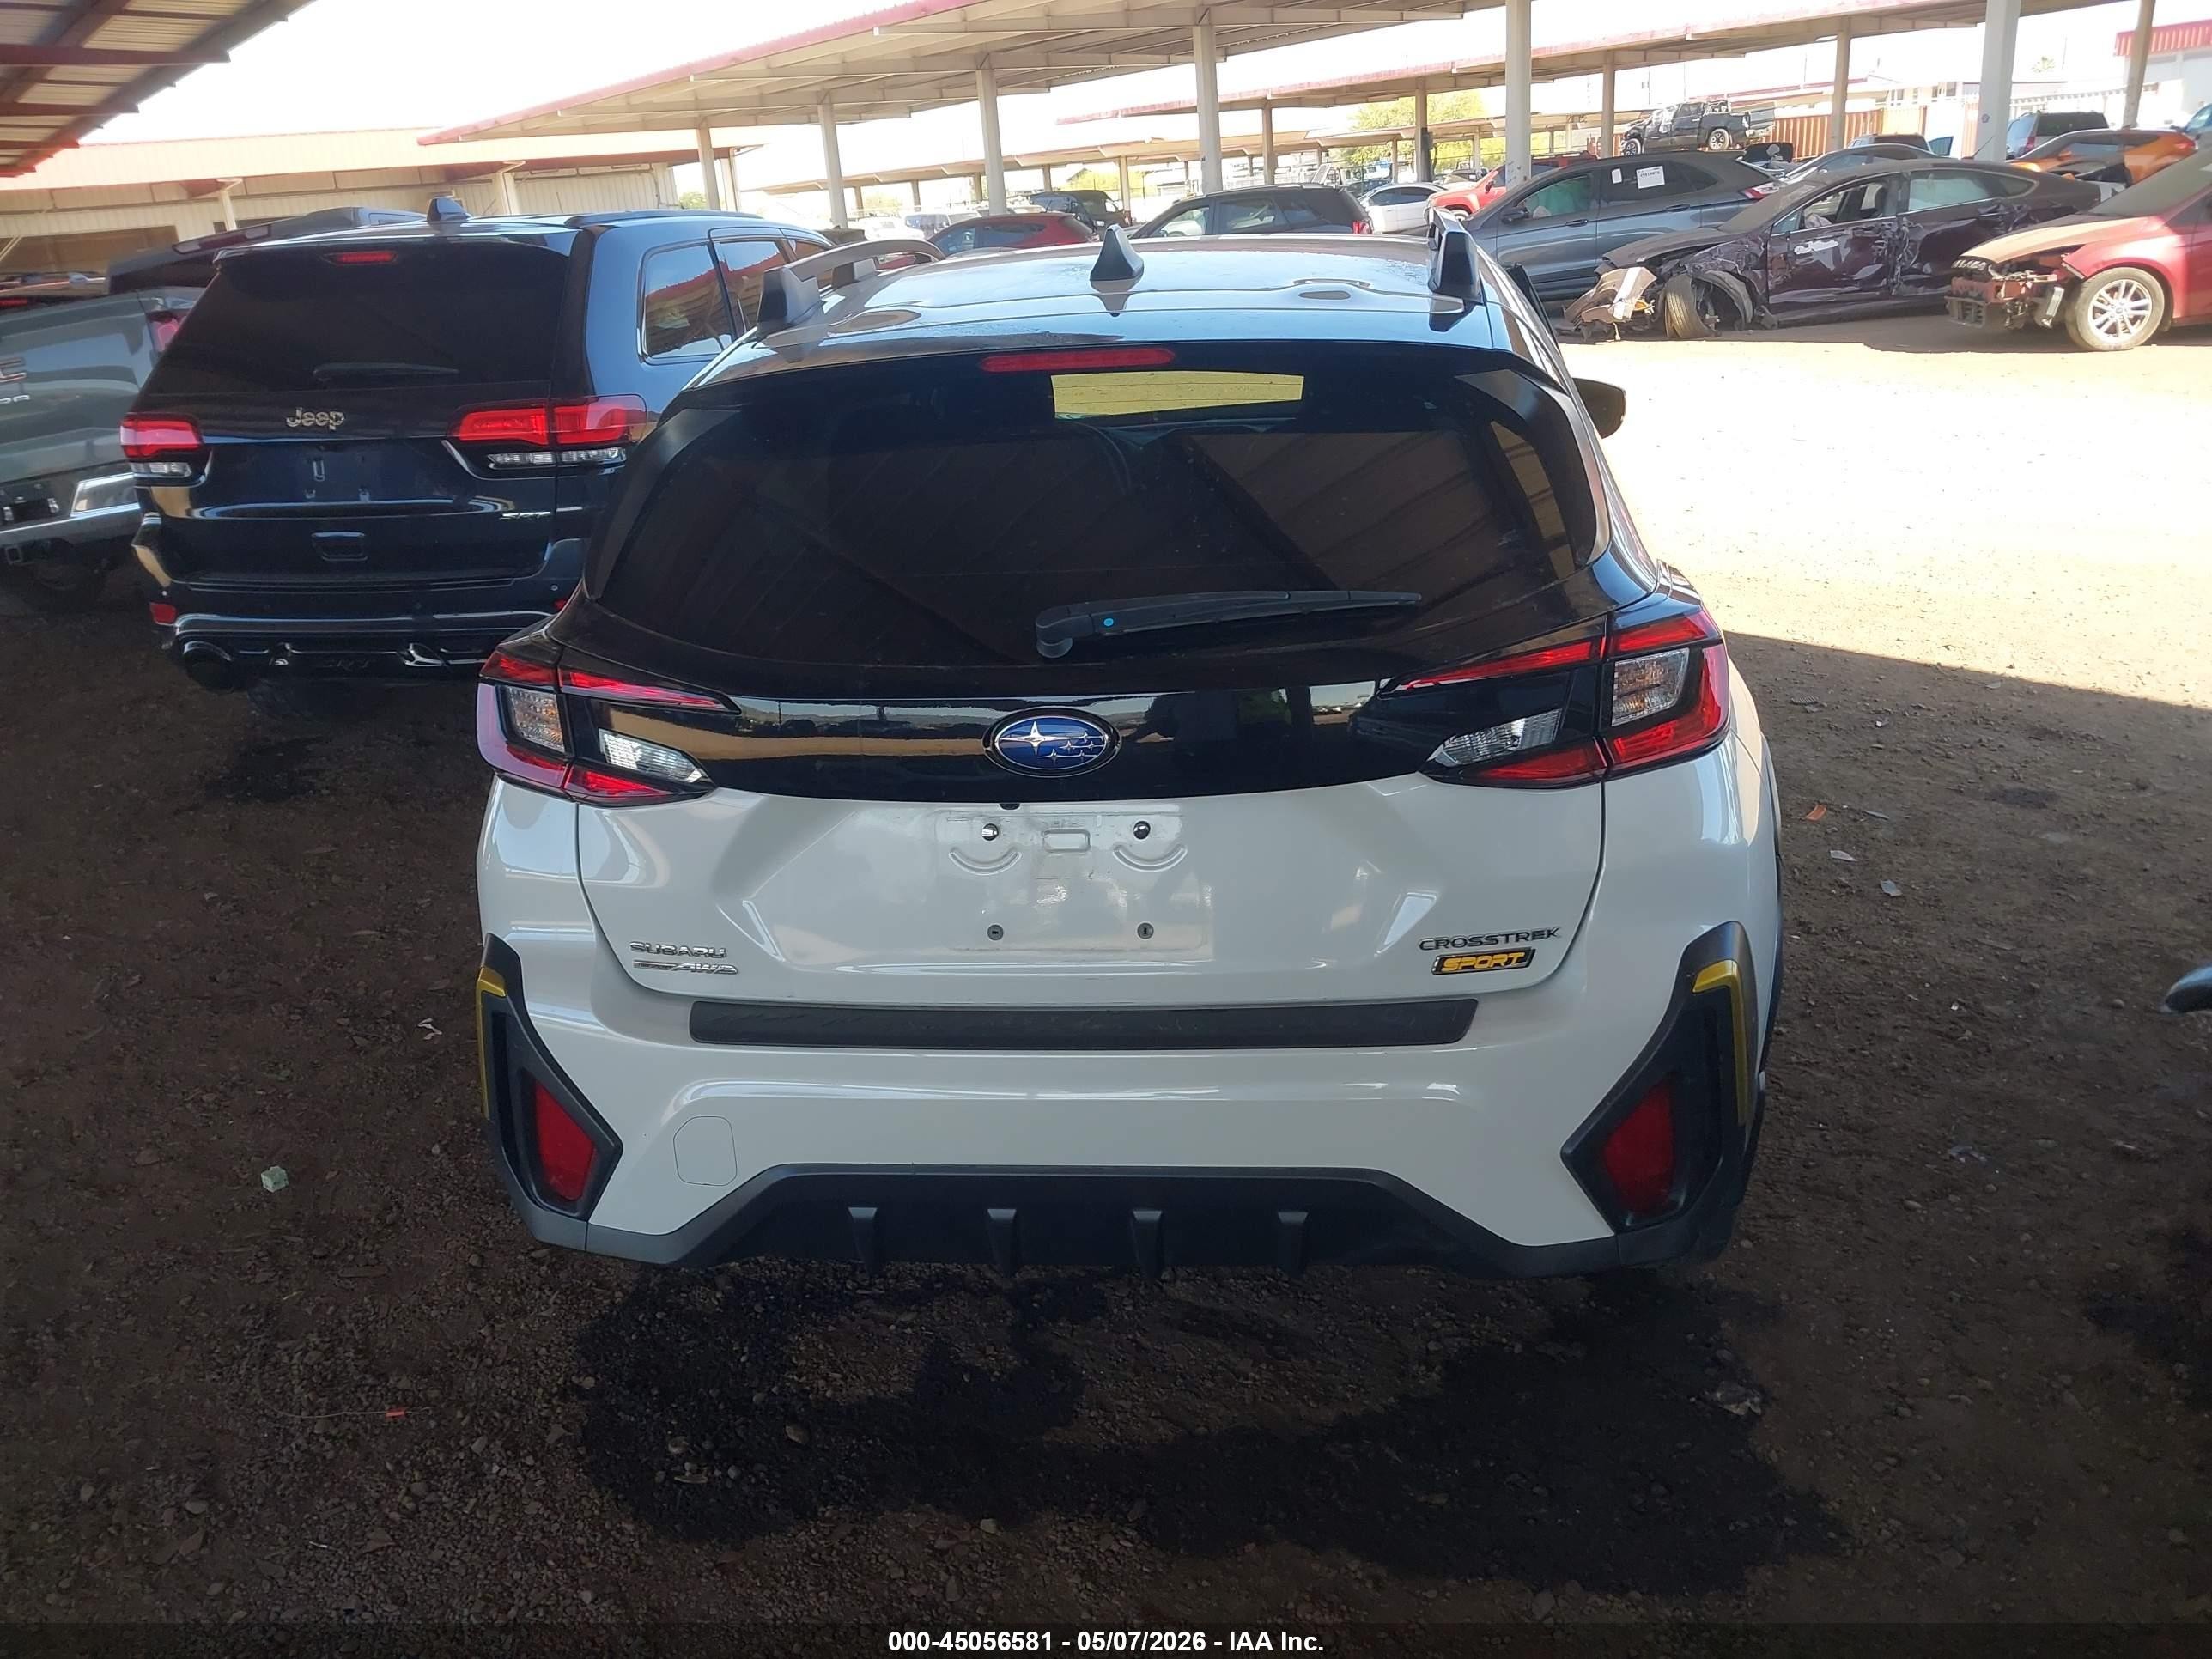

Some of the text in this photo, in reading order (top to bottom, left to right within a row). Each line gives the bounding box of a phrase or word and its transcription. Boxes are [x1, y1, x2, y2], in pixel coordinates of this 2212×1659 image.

[286, 406, 345, 430] Jeep
[1419, 927, 1561, 951] CROSSTREK
[629, 941, 728, 959] SUBARU
[672, 962, 739, 975] AWD
[1441, 951, 1526, 972] SPORT
